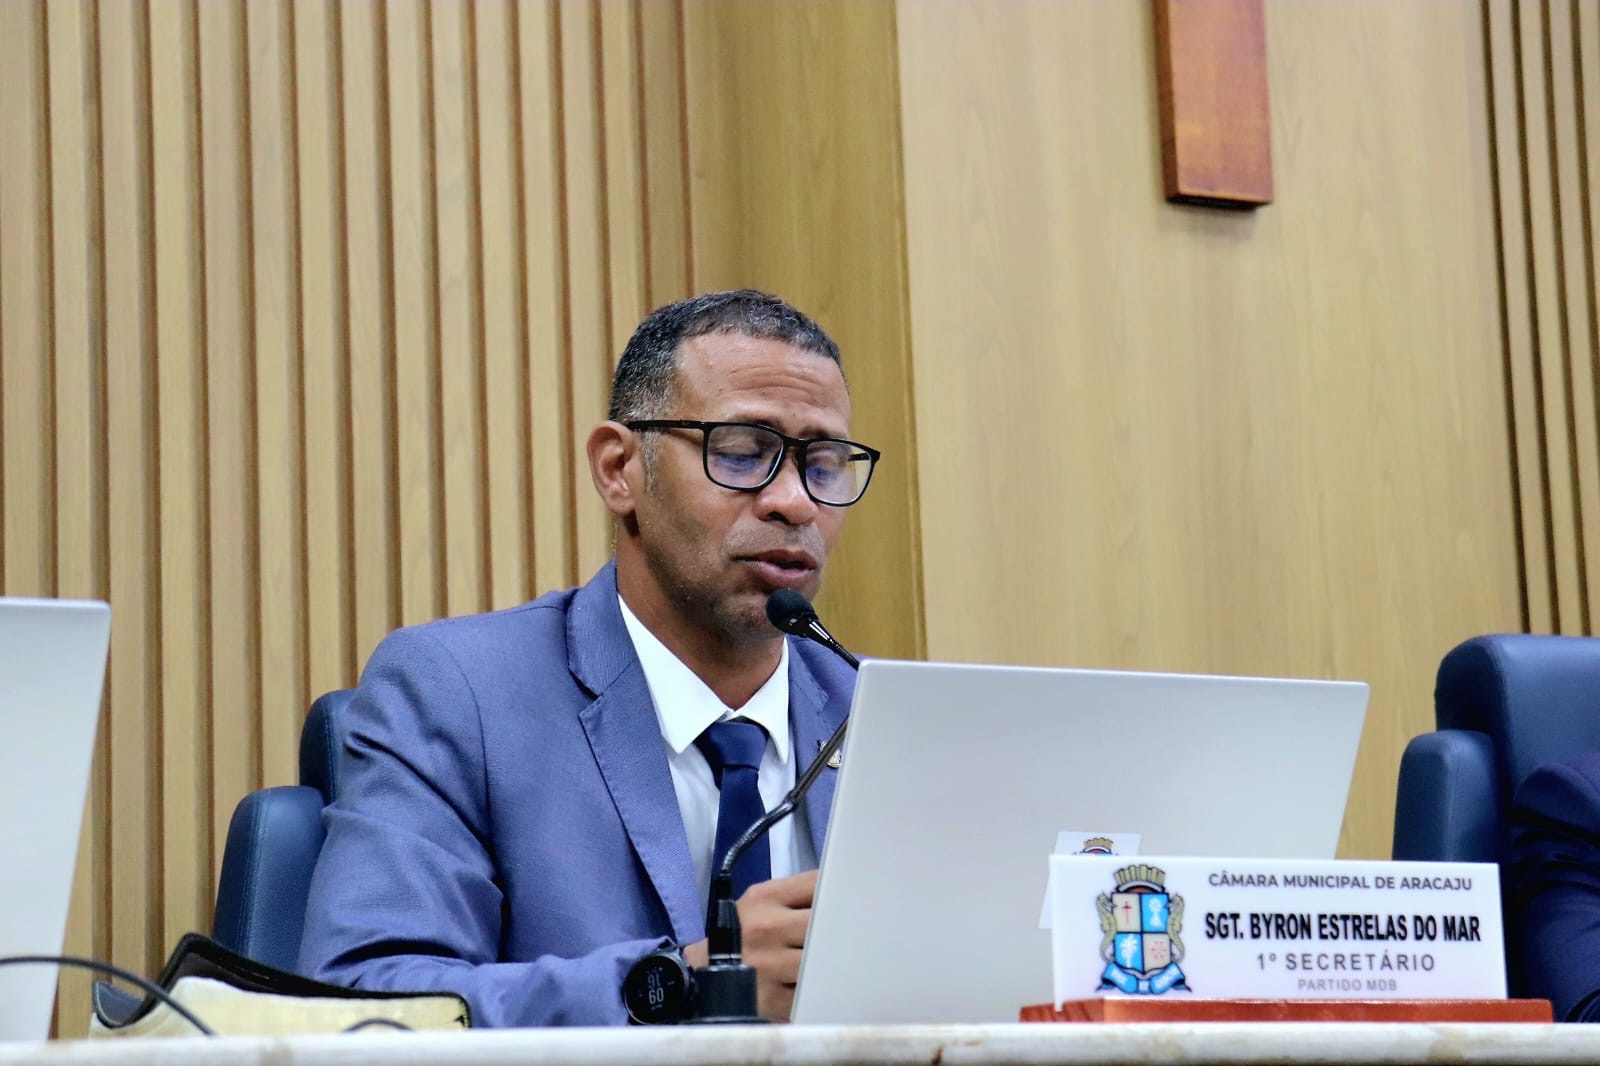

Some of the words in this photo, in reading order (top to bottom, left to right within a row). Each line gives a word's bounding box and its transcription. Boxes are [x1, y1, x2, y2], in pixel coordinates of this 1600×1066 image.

[1208, 870, 1279, 888] CÂMARA
[1283, 874, 1371, 889] MUNICIPAL
[1374, 876, 1396, 890] DE
[1400, 876, 1472, 891] ARACAJU
[1204, 912, 1244, 940] SGT.
[1249, 912, 1312, 941] BYRON
[1317, 913, 1408, 942] ESTRELAS
[1412, 914, 1438, 942] DO
[1442, 915, 1481, 942] MAR
[1285, 949, 1435, 972] SECRETÁRIO
[1297, 978, 1363, 992] PARTIDO
[1365, 978, 1398, 992] MDB
